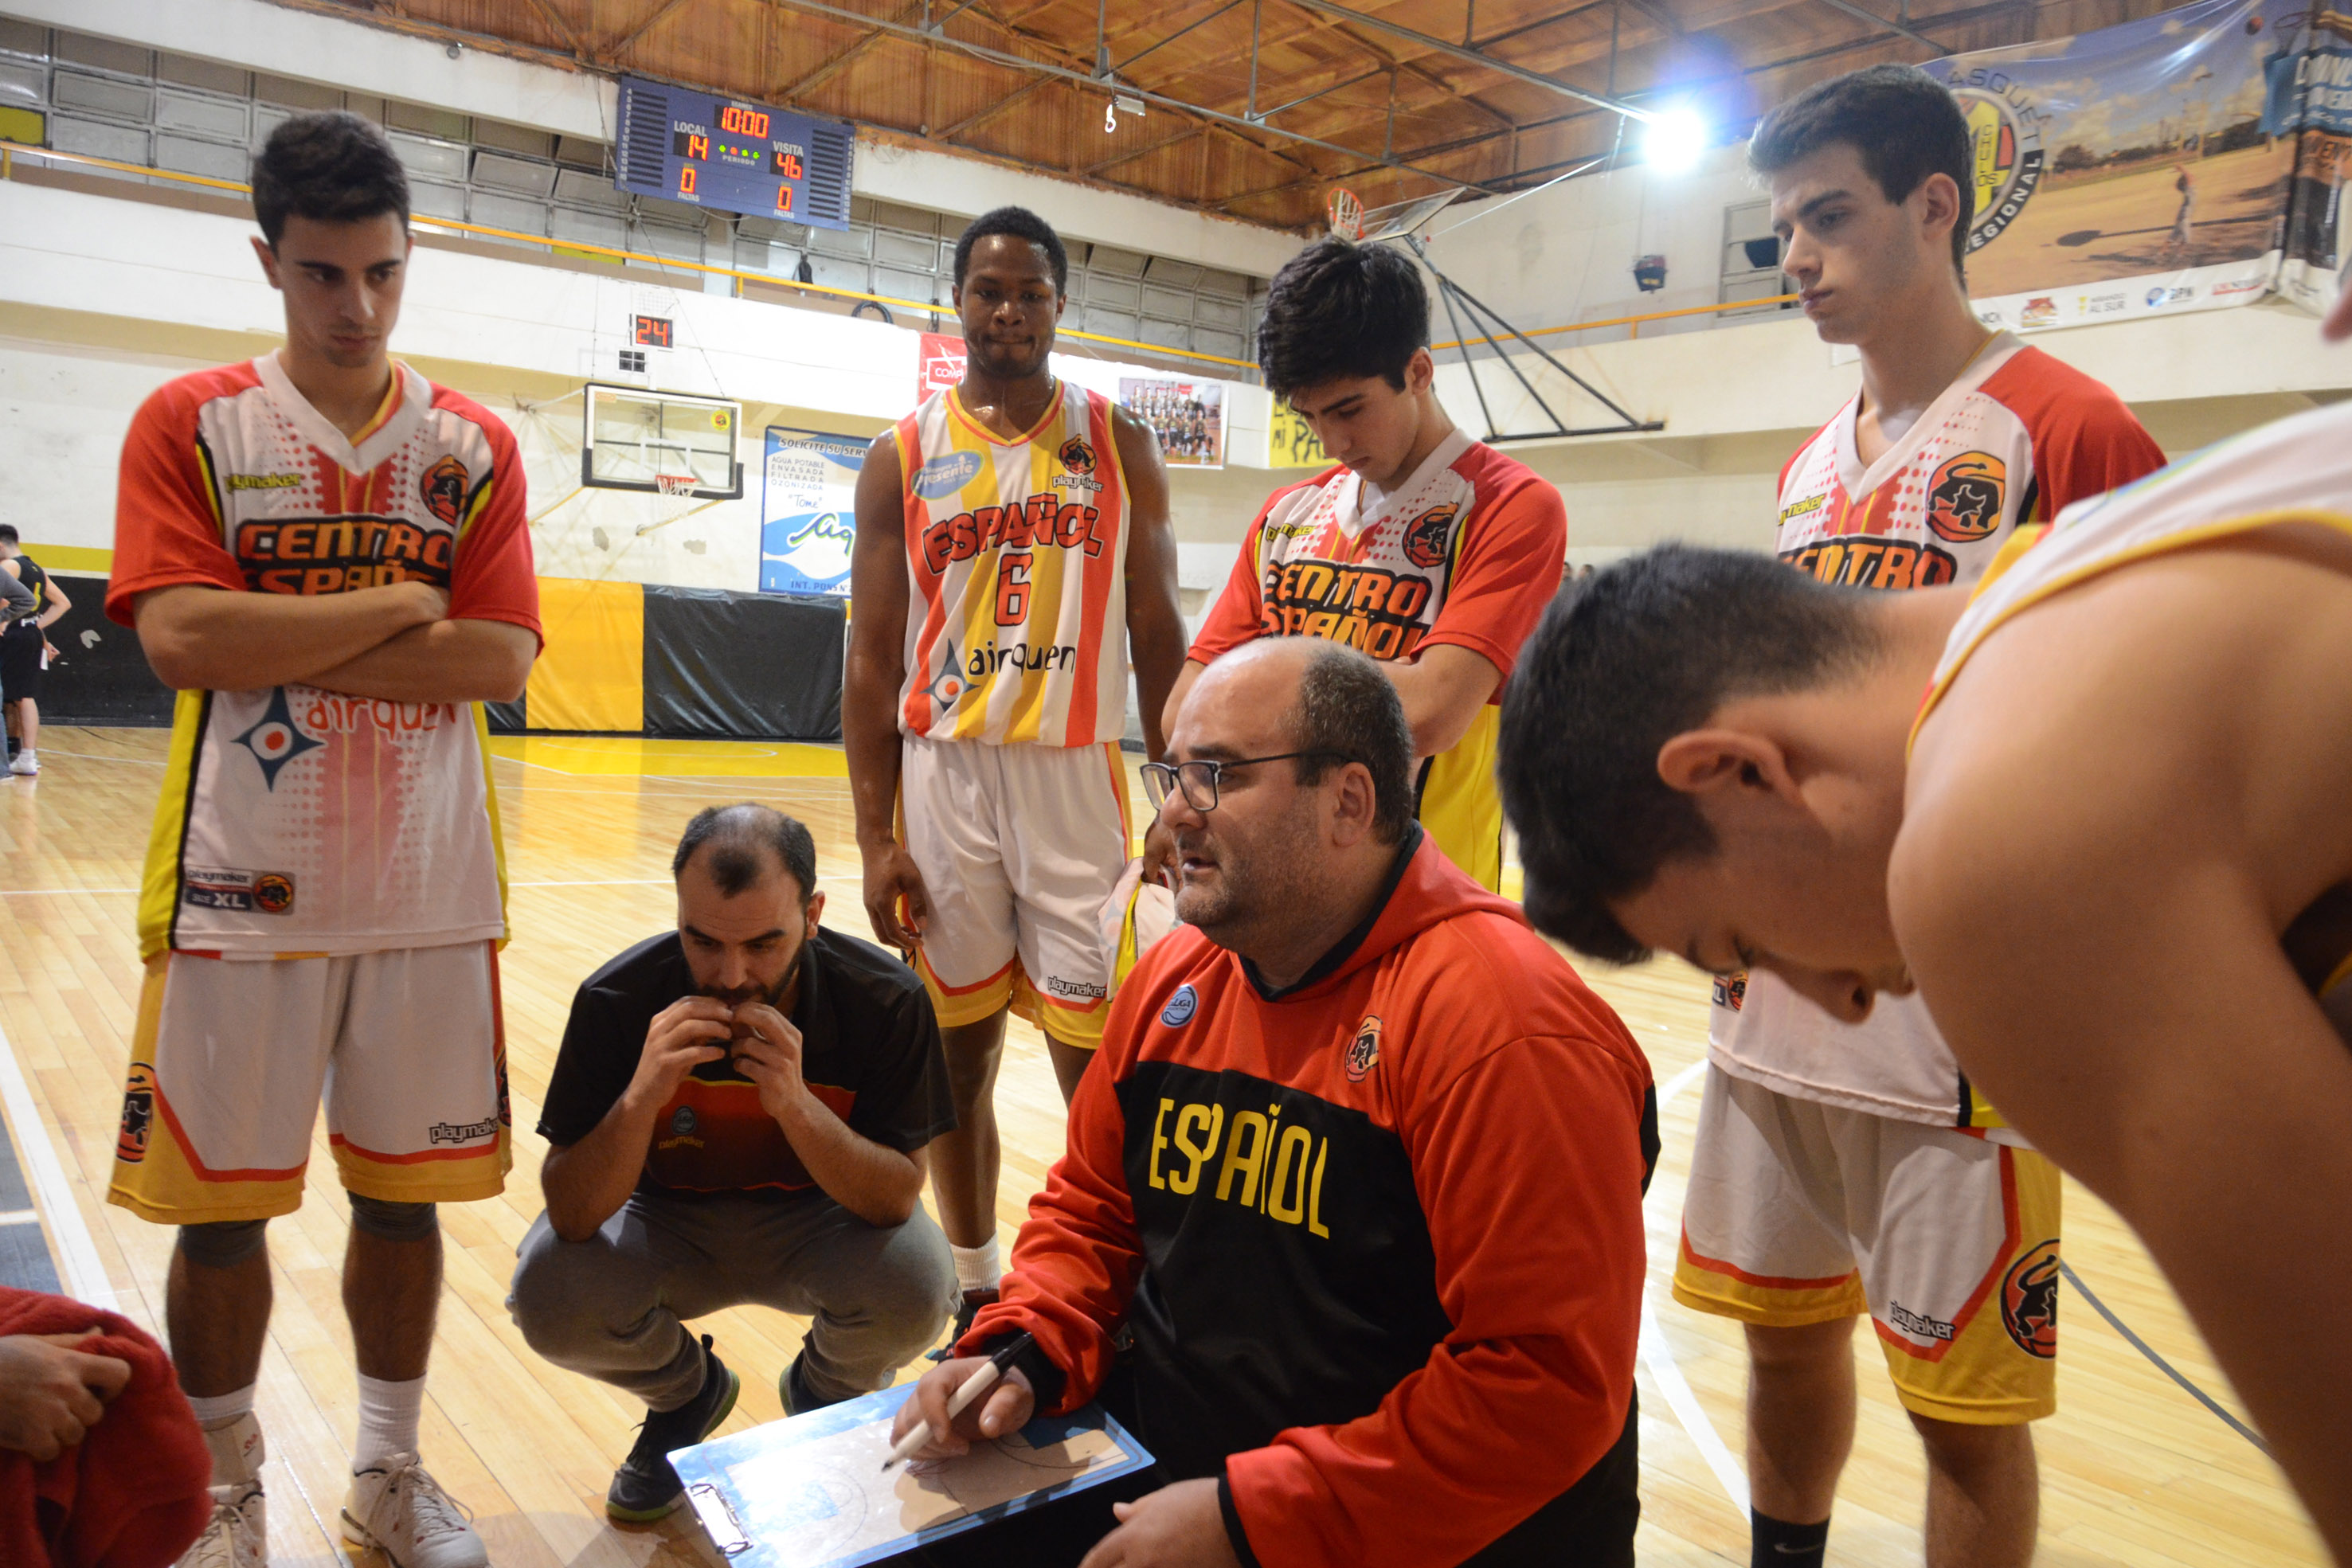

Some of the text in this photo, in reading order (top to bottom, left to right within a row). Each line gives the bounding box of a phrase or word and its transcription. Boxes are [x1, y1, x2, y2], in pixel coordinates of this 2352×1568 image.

[674, 120, 708, 137] LOCAL
[688, 135, 710, 162] 14
[773, 140, 804, 157] VISITA
[722, 154, 755, 166] PERIODO
[680, 166, 697, 194] 0
[677, 191, 699, 202] FALTAS
[777, 186, 793, 212] 0
[773, 209, 795, 219] FALTAS
[1965, 158, 2041, 254] EGIONAL
[636, 319, 668, 346] 24
[781, 439, 825, 452] SOLICITE
[828, 444, 841, 453] SU
[771, 464, 824, 475] ENVASADA
[795, 459, 825, 468] POTABLE
[771, 471, 824, 483] FILTRADA
[771, 479, 823, 491] OZONIZADA
[922, 492, 1105, 574] ESPAÑOL
[239, 520, 452, 572] CENTRO
[994, 553, 1034, 627] 6
[1264, 563, 1427, 616] CENTRO
[968, 643, 1076, 677] airquen
[213, 892, 247, 908] XL
[1047, 976, 1106, 998] playmaker
[658, 1135, 706, 1149] playmaker
